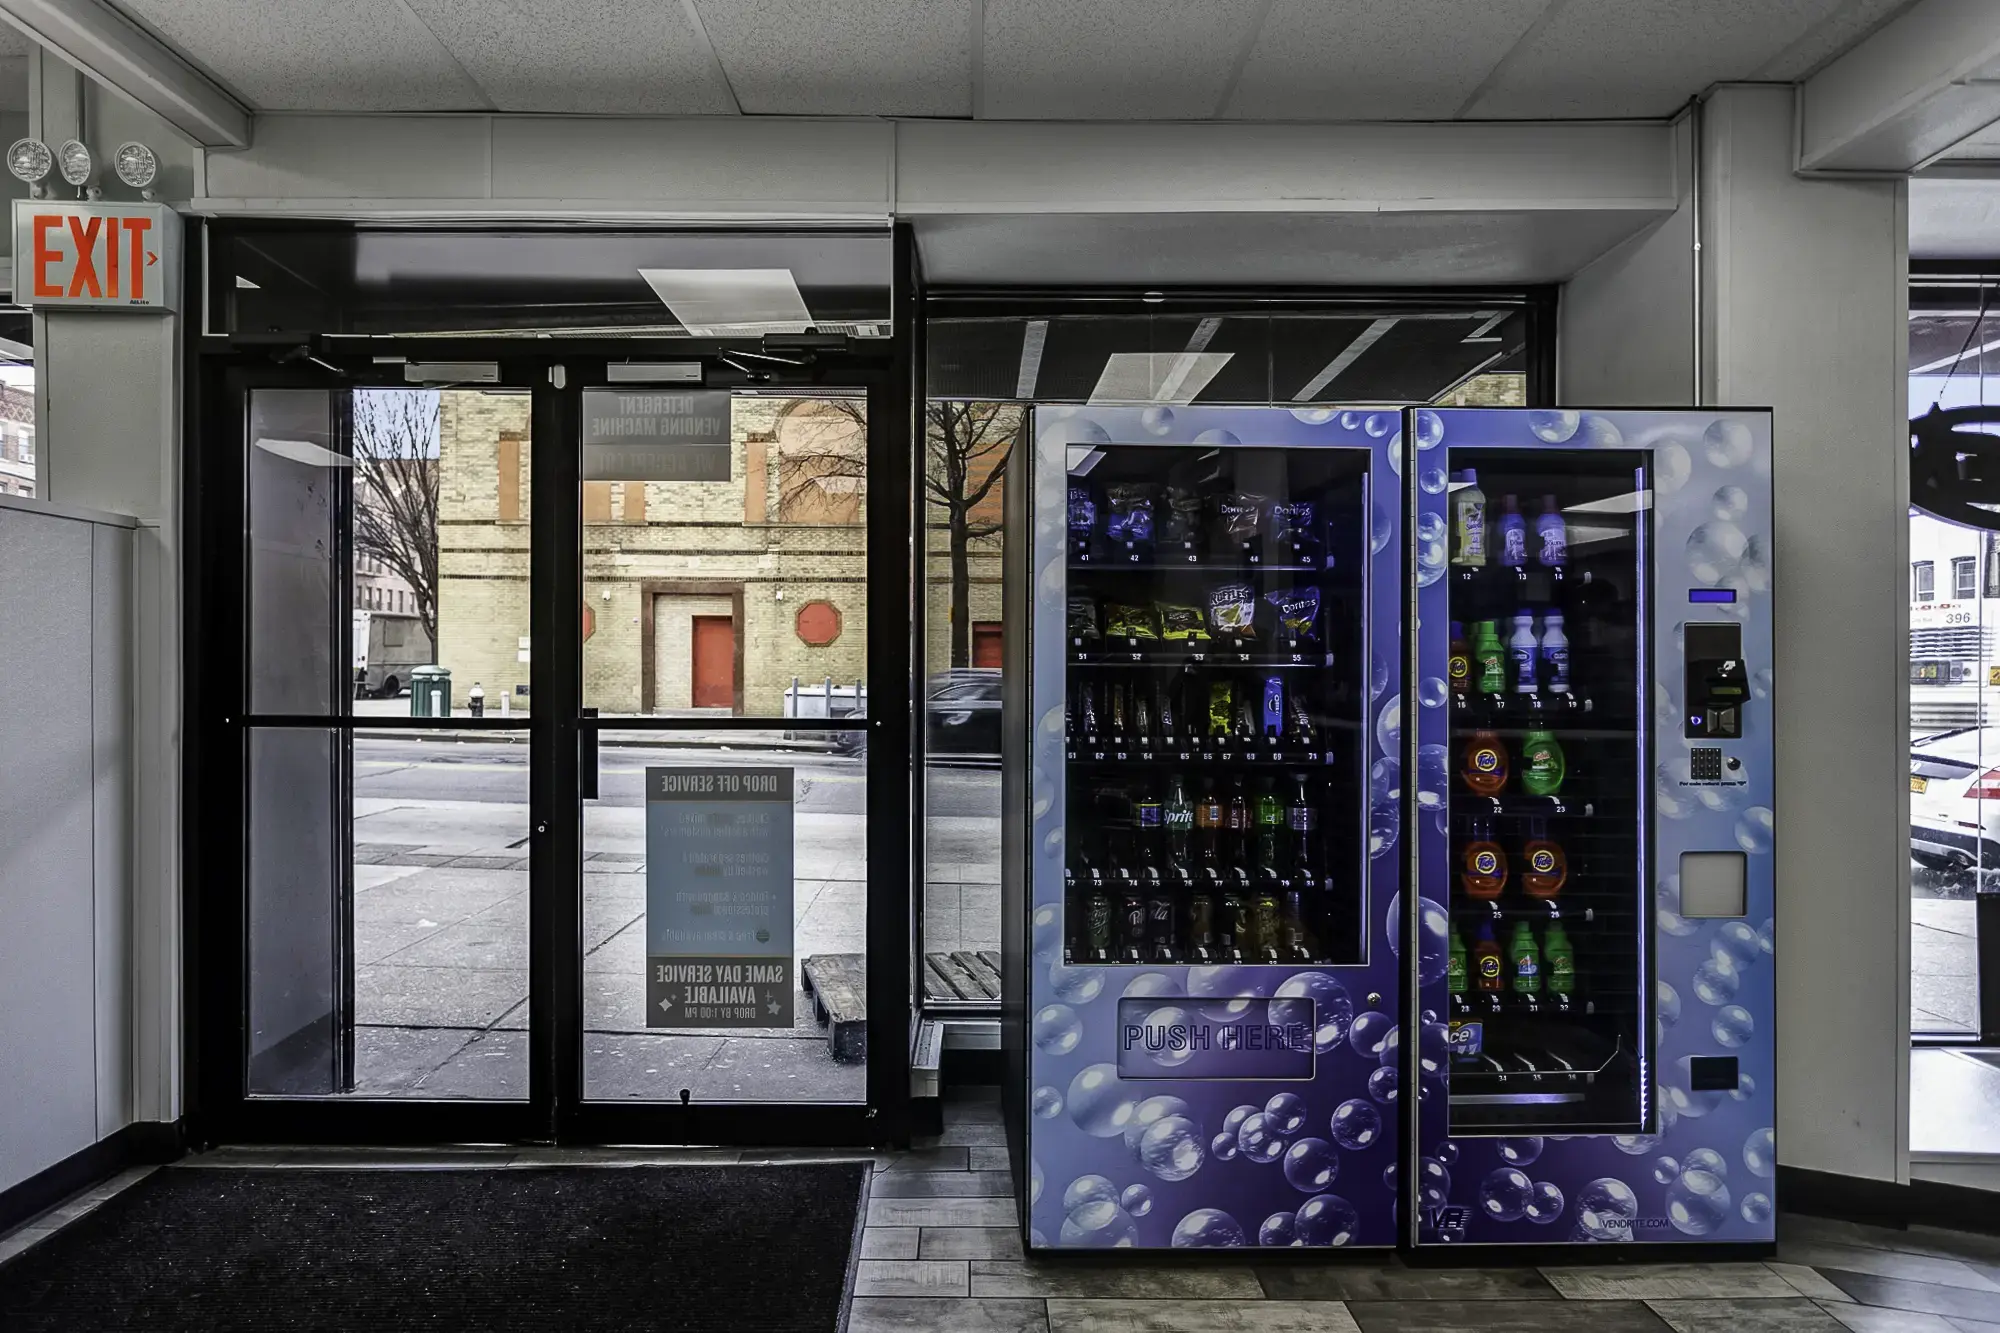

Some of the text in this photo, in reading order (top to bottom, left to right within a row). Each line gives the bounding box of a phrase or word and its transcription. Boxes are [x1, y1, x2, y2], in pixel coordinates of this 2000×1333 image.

[33, 215, 152, 299] EXIT
[1282, 599, 1316, 614] Doritos
[1945, 612, 1971, 624] 396
[1143, 752, 1153, 760] 64
[1493, 911, 1502, 919] 25
[1124, 1024, 1304, 1051] PUSH HERE
[1602, 1219, 1669, 1229] VENDRITE.COM
